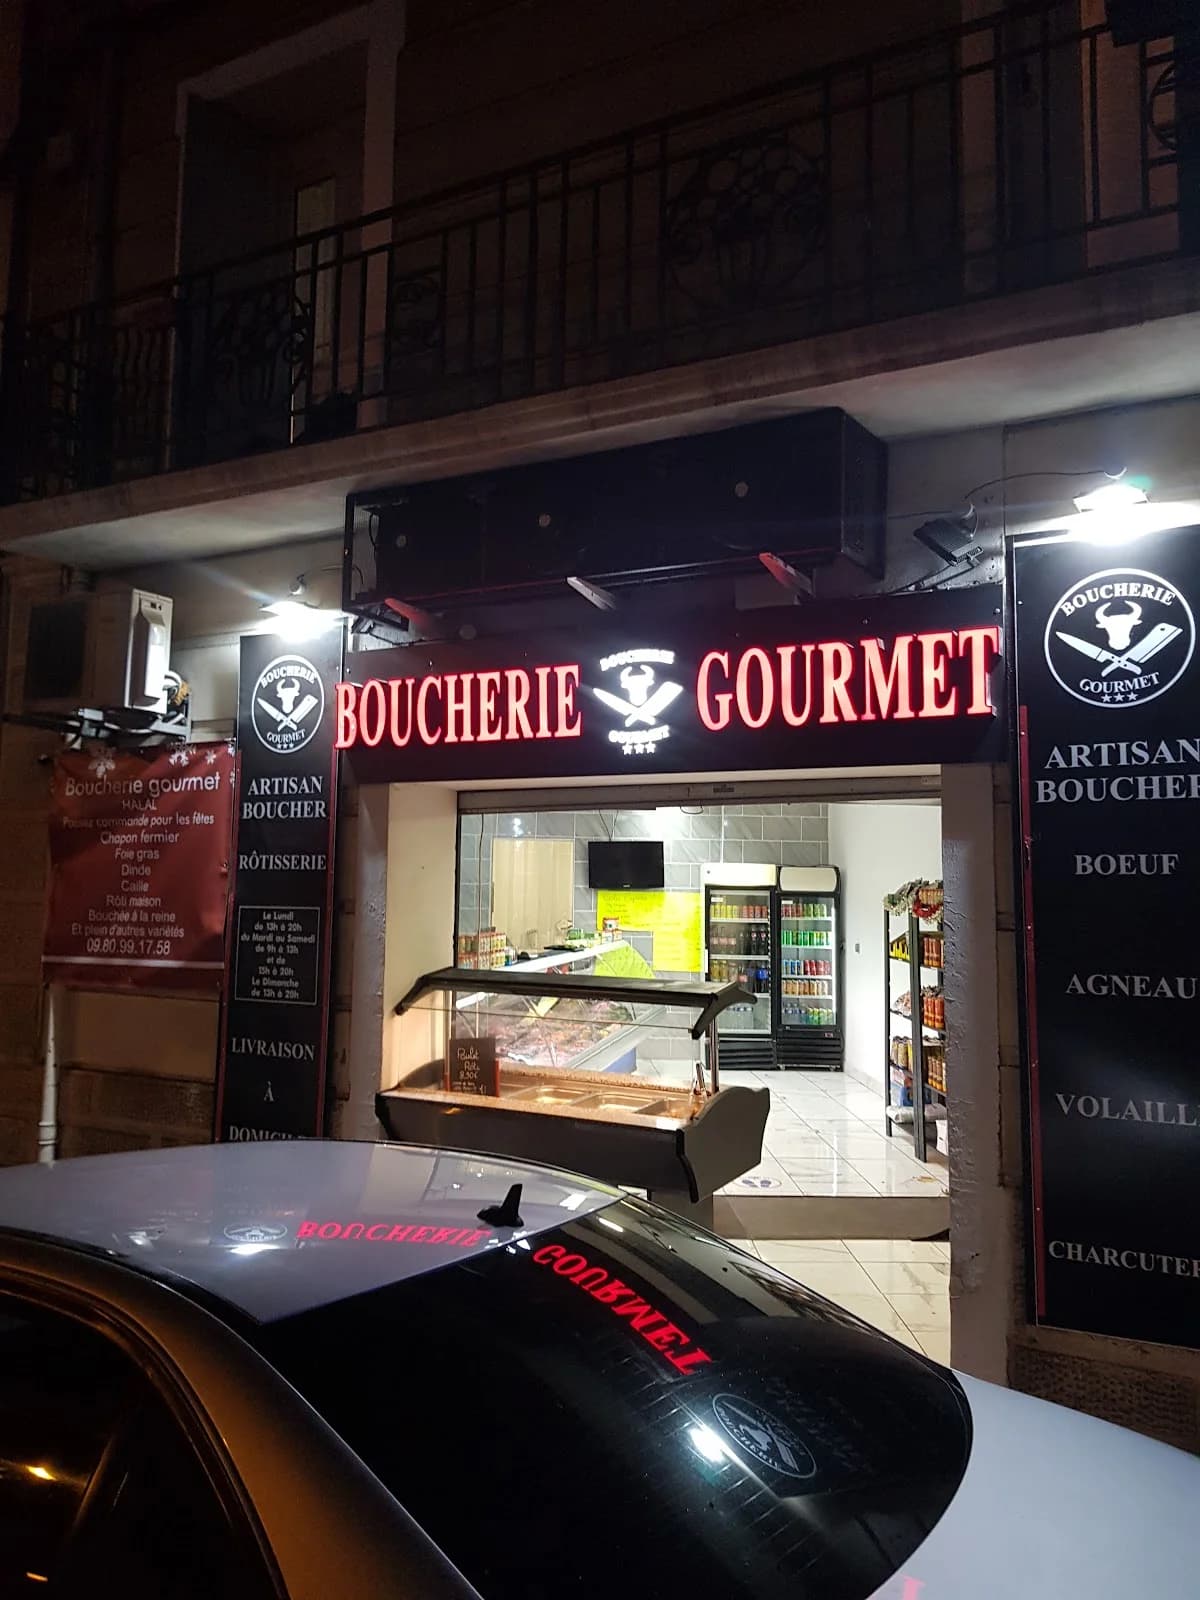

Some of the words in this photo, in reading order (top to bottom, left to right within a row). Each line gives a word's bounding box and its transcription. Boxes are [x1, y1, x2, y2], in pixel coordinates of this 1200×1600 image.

[1059, 582, 1177, 617] BOUCHERIE
[260, 665, 316, 689] BOUCHERIE
[334, 664, 583, 749] BOUCHERIE
[696, 626, 1002, 731] GOURMET
[1079, 672, 1160, 694] GOURMET
[266, 728, 307, 744] GOURMET
[1044, 738, 1200, 769] ARTISAN
[65, 774, 142, 796] Boucherie
[149, 772, 221, 798] gourmet
[248, 775, 323, 796] ARTISAN
[122, 799, 158, 811] HALAL
[242, 800, 327, 820] BOUCHER
[150, 815, 173, 828] pour
[176, 812, 190, 825] les
[193, 811, 215, 825] fêtes
[101, 831, 138, 848] Chapon
[140, 831, 180, 844] fermier
[115, 849, 135, 860] Foie
[137, 850, 160, 862] gras
[239, 850, 327, 871] RÔTISSERIE
[1075, 853, 1179, 876] BOEUF
[121, 864, 151, 876] Dinde
[121, 880, 149, 892] Caille
[129, 895, 162, 907] maison
[88, 909, 130, 922] Bouchée
[140, 910, 149, 922] la
[151, 911, 176, 923] reine
[72, 922, 83, 935] Et
[85, 923, 108, 937] plein
[109, 924, 145, 937] d'autres
[148, 925, 185, 938] variétés
[86, 938, 171, 955] 09.80.99.17.58
[1065, 973, 1197, 999] AGNEAU
[232, 1037, 316, 1061] LIVRAISON
[263, 1081, 275, 1102] À
[1056, 1093, 1200, 1127] VOLAILL
